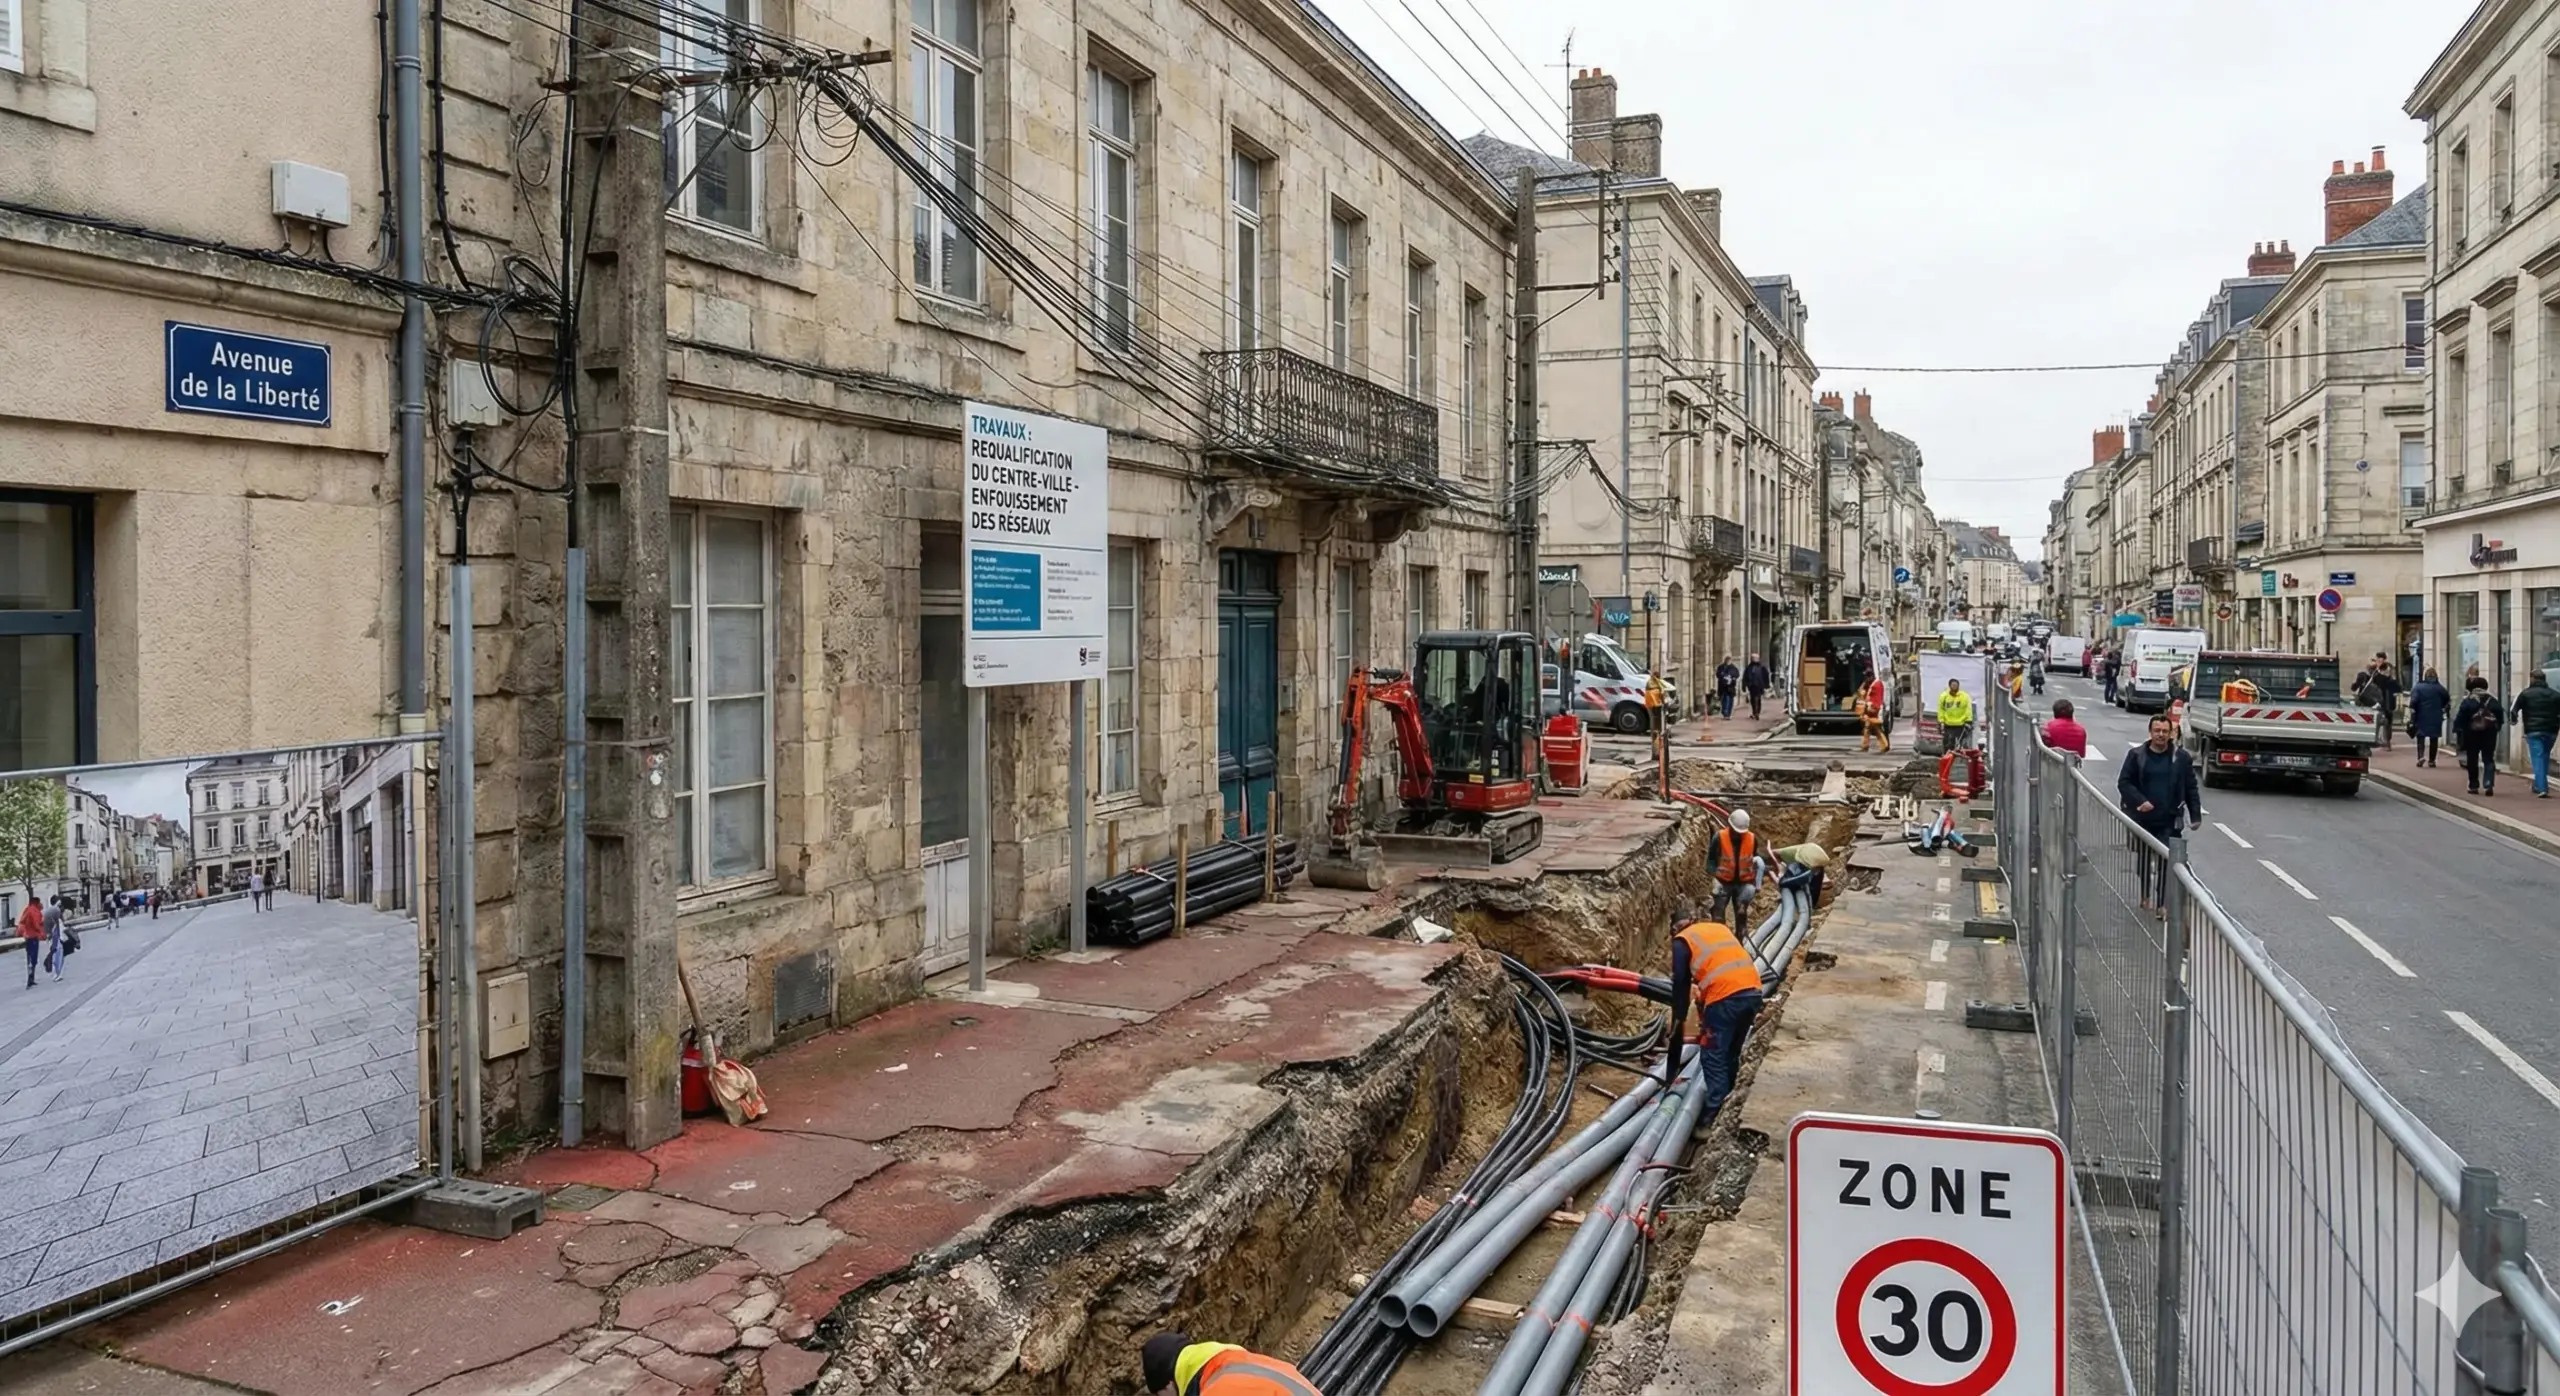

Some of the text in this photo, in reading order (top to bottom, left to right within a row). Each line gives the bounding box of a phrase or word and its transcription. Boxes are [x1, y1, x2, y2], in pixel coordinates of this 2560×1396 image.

[211, 341, 293, 376] Avenue
[181, 372, 320, 411] de la Liberté
[971, 415, 1026, 440] TRAVAUX
[971, 439, 1073, 471] REQUALIFICATION
[971, 463, 989, 481] DU
[992, 466, 1073, 492] CENTRE-VILLE
[971, 487, 1069, 515] ENFOUISSEMENT
[971, 509, 1052, 536] DES RÉSEAUX
[1839, 1158, 2012, 1220] ZONE
[1869, 1284, 1983, 1363] 30
